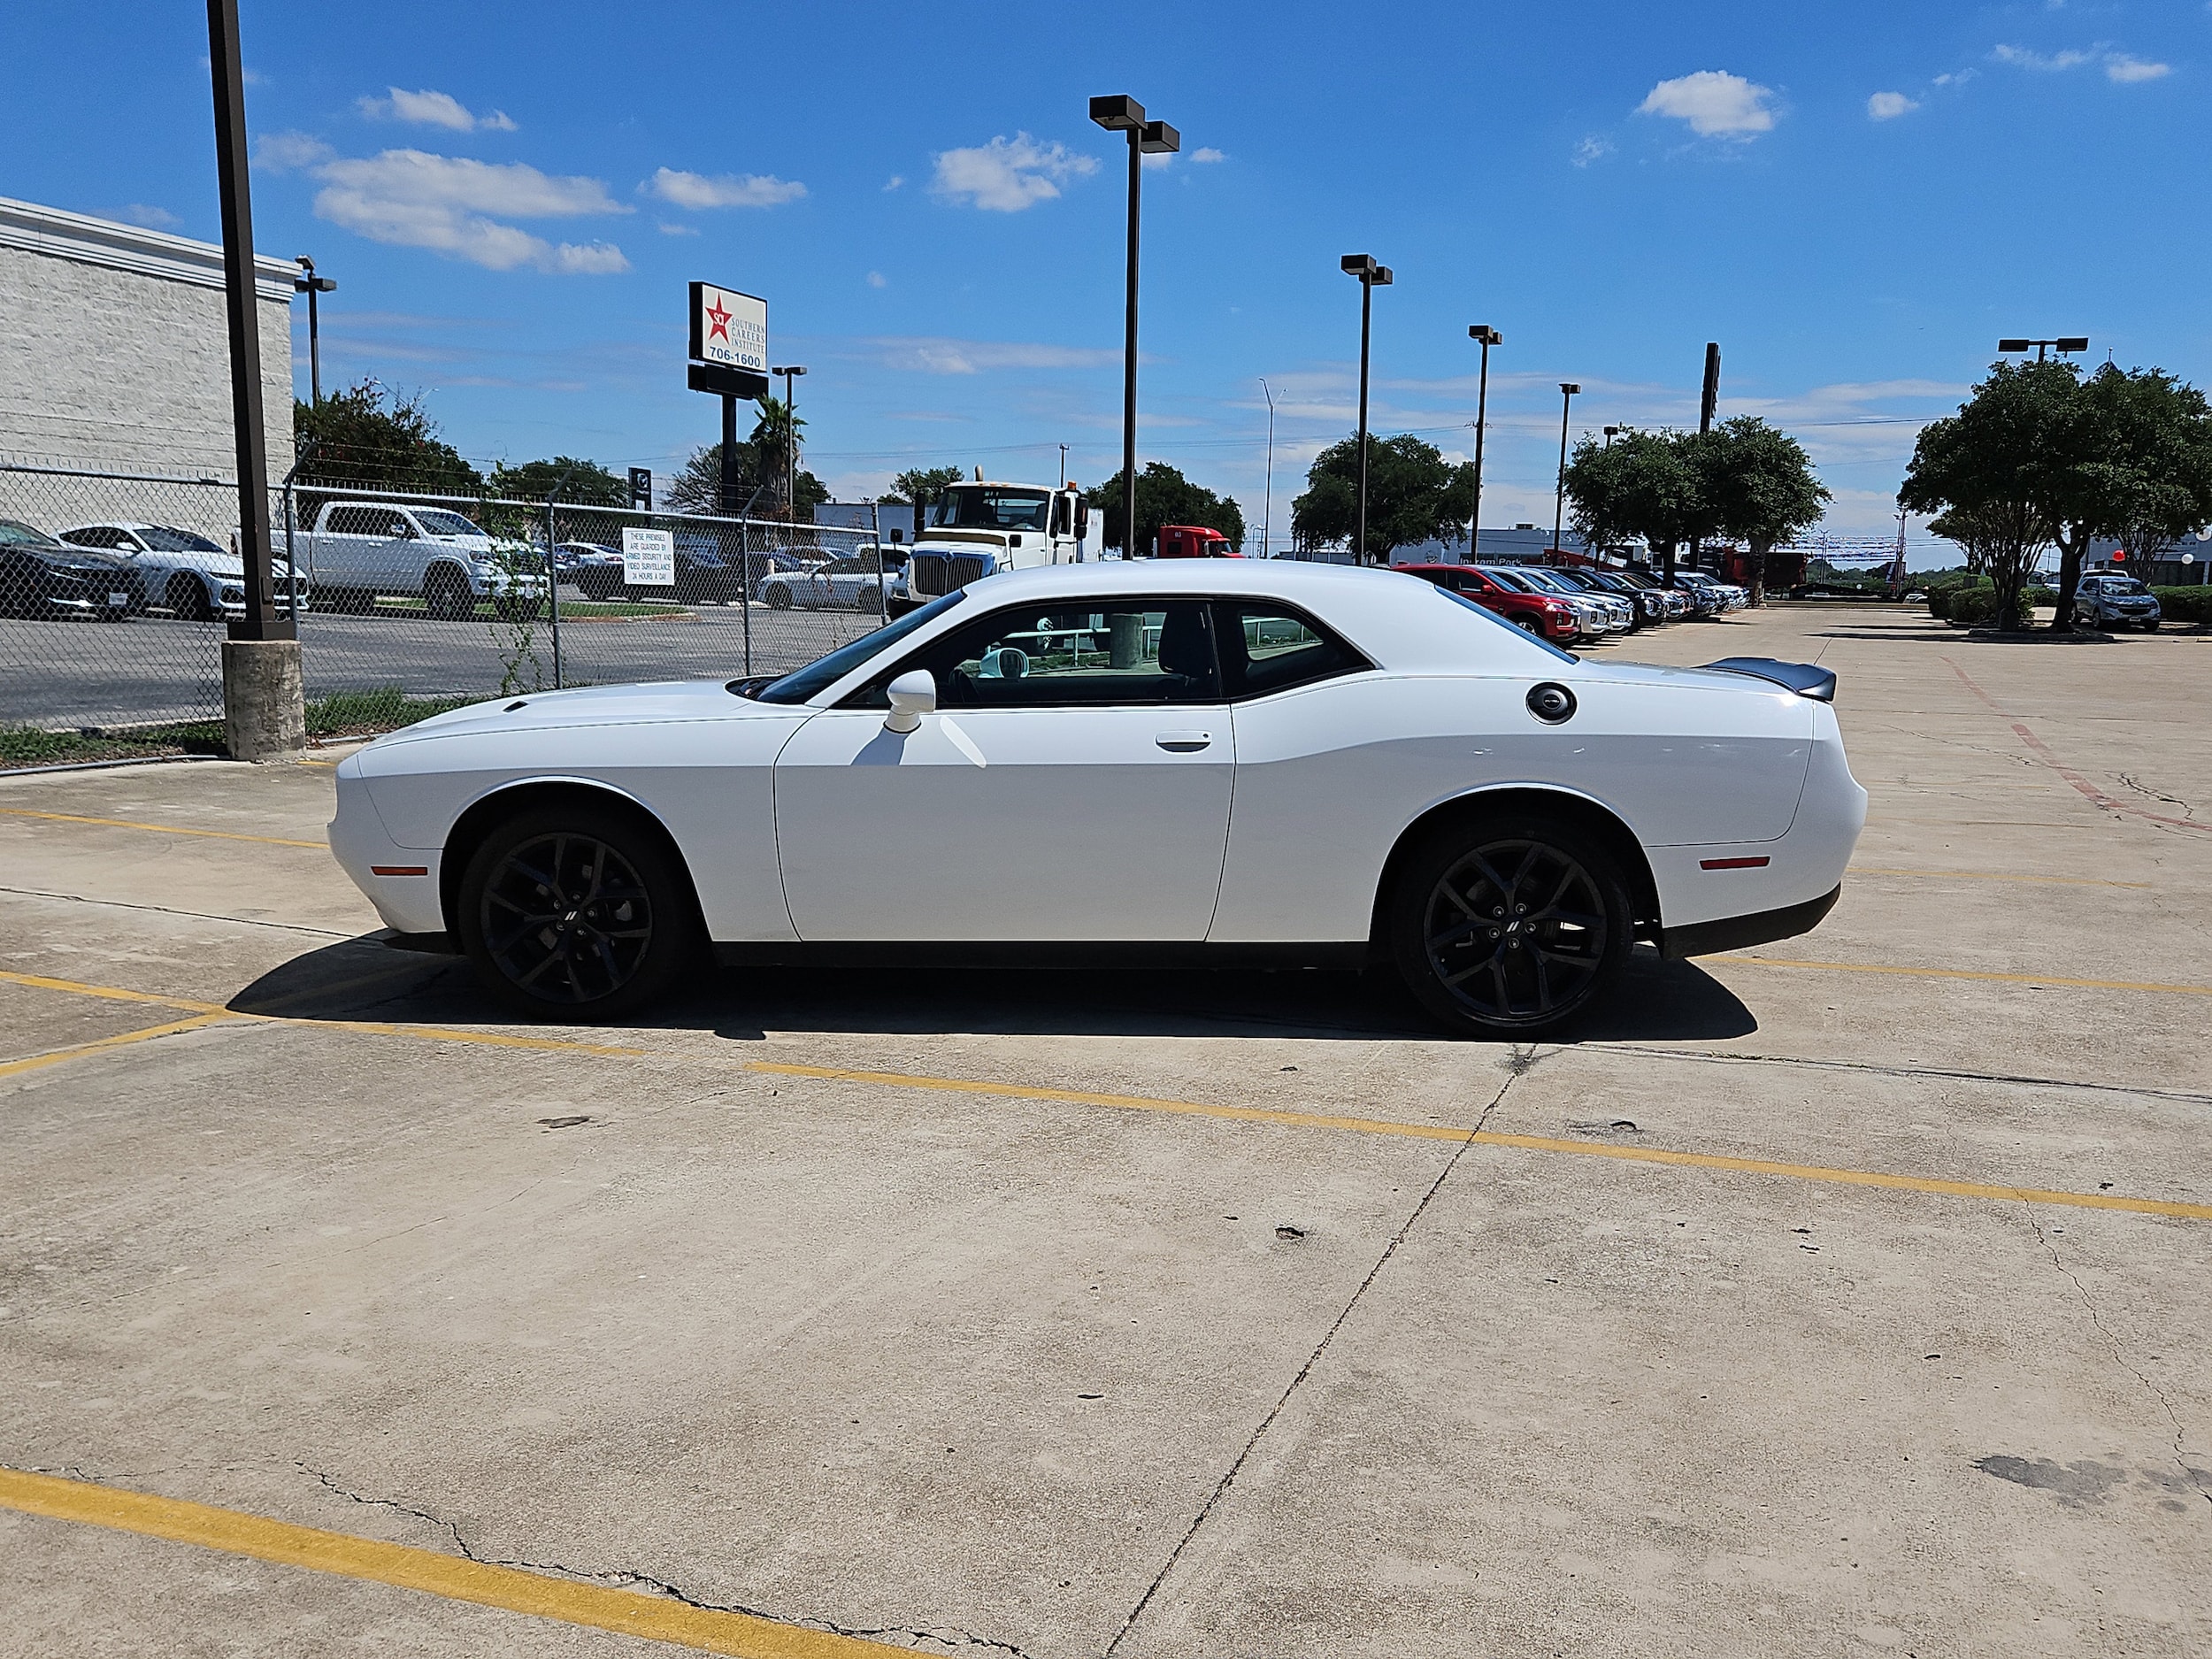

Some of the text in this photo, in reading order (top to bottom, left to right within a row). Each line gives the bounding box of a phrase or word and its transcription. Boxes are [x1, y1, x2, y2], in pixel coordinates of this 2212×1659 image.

[732, 318, 764, 334] SOUTHERN
[732, 327, 764, 343] CAREERS
[732, 338, 764, 354] INSTITUTE
[710, 346, 760, 368] 706-1600
[1499, 557, 1522, 566] Park
